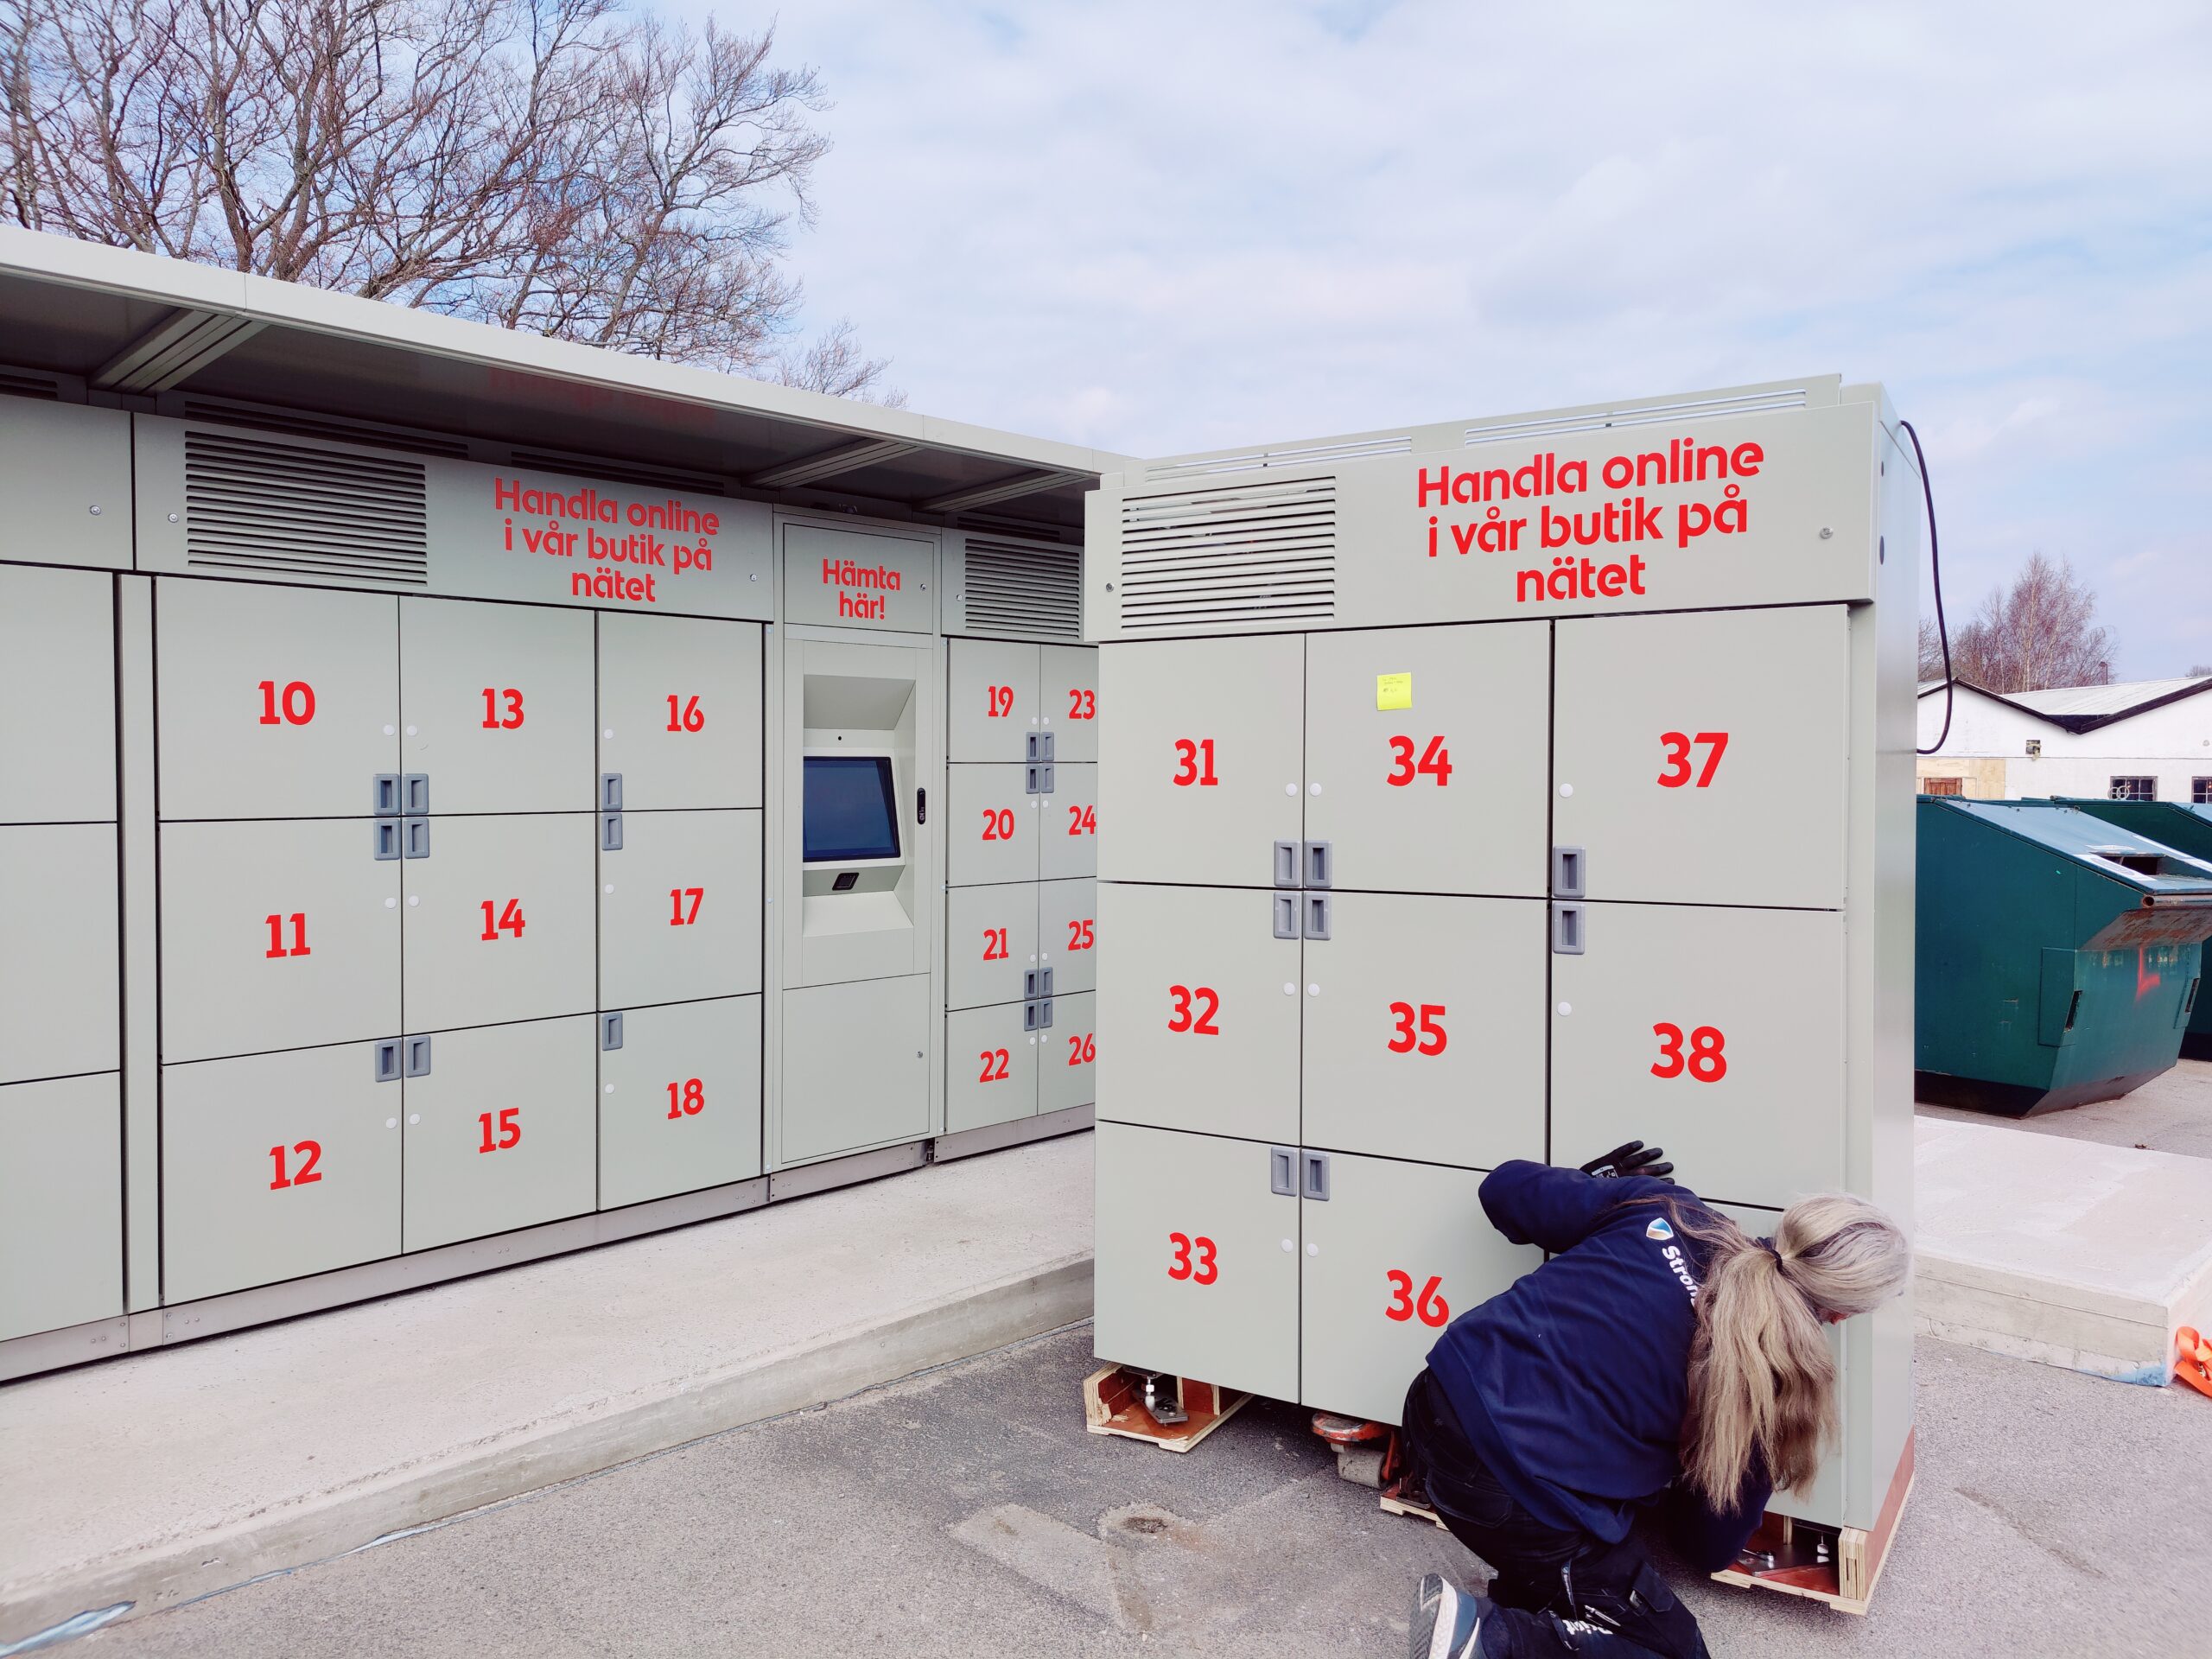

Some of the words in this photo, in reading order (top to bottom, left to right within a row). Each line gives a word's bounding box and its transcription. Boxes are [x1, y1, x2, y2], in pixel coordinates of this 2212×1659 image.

[1418, 452, 1588, 508] Handla
[1601, 436, 1765, 490] online
[494, 477, 619, 524] Handla
[626, 499, 720, 536] online
[1428, 516, 1439, 557] i
[1451, 506, 1528, 555] vår
[1541, 496, 1664, 549] butik
[1678, 483, 1748, 549] på
[505, 518, 512, 551] i
[522, 520, 579, 557] vår
[588, 527, 666, 567] butik
[673, 537, 713, 575] på
[571, 566, 657, 603] nätet
[822, 558, 901, 591] Hämta
[1516, 554, 1647, 603] nätet
[838, 591, 887, 620] här!
[258, 681, 316, 726] 10
[482, 688, 525, 730] 13
[666, 694, 705, 734] 16
[988, 685, 1014, 718] 19
[1068, 689, 1096, 721] 23
[1173, 738, 1219, 787] 31
[1387, 734, 1453, 788] 34
[1657, 732, 1729, 789] 37
[982, 804, 1015, 842] 20
[1068, 804, 1096, 836] 24
[480, 899, 526, 942] 14
[669, 887, 704, 927] 17
[264, 912, 312, 959] 11
[982, 926, 1009, 962] 21
[1068, 919, 1095, 951] 25
[1167, 984, 1220, 1036] 32
[1387, 1001, 1448, 1057] 35
[979, 1047, 1010, 1084] 22
[1068, 1033, 1096, 1067] 26
[1650, 1021, 1728, 1084] 38
[666, 1077, 705, 1121] 18
[479, 1107, 522, 1154] 15
[270, 1140, 323, 1191] 12
[1167, 1232, 1219, 1286] 33
[1385, 1268, 1451, 1328] 36
